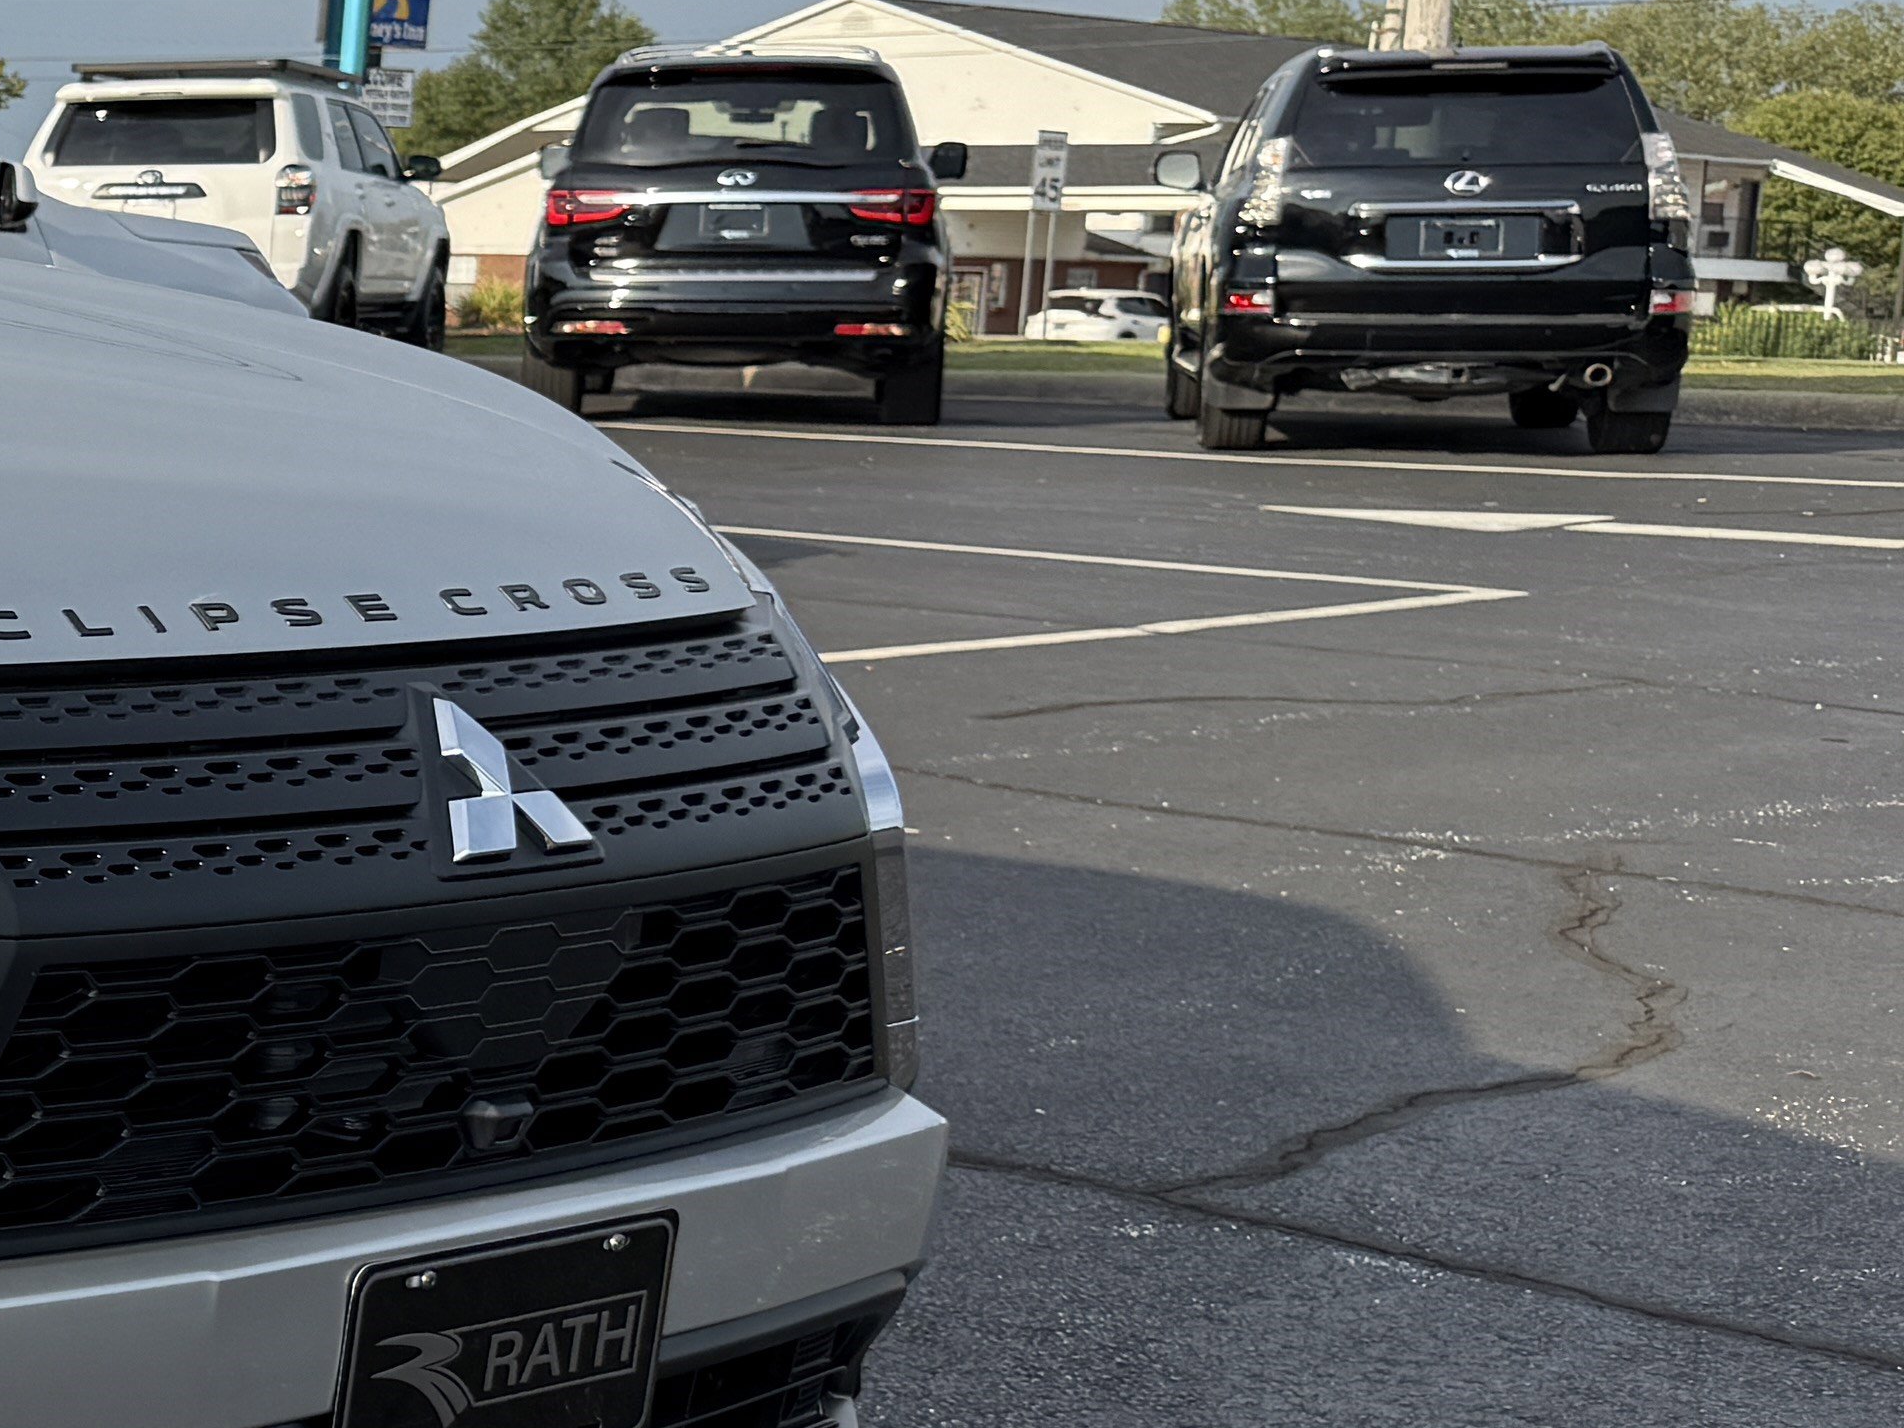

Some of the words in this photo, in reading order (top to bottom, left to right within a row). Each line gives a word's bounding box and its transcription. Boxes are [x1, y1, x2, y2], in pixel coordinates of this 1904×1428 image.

[1033, 177, 1060, 202] 45
[439, 566, 712, 616] CROSS
[483, 1304, 637, 1392] RATH
